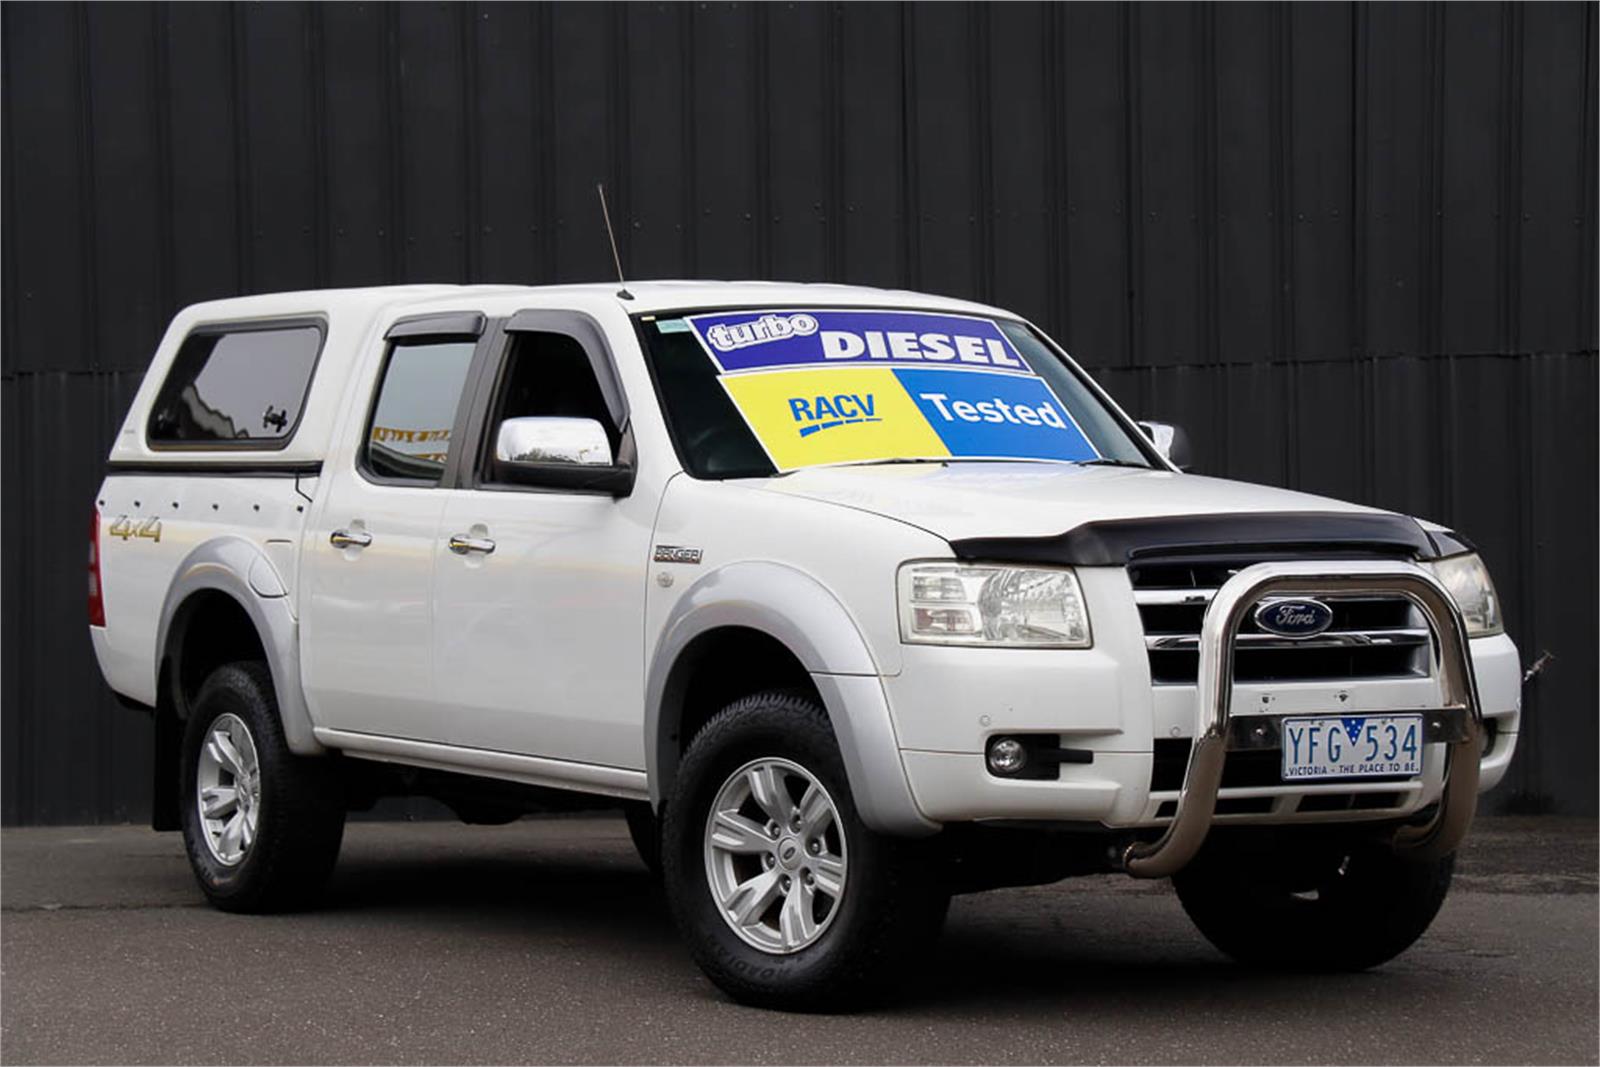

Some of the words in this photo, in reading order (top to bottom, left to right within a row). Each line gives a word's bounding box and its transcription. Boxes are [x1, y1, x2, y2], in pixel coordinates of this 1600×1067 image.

[708, 314, 818, 349] turbo
[820, 331, 1020, 367] DIESEL
[788, 394, 874, 422] RACV
[919, 393, 1067, 429] Tested
[1276, 605, 1315, 625] Ford
[1288, 727, 1341, 765] YFG
[1365, 724, 1418, 762] 534
[1288, 766, 1328, 776] VICTORIA
[1339, 764, 1356, 773] THE
[1359, 763, 1384, 773] PLACE
[1389, 763, 1400, 772] TO
